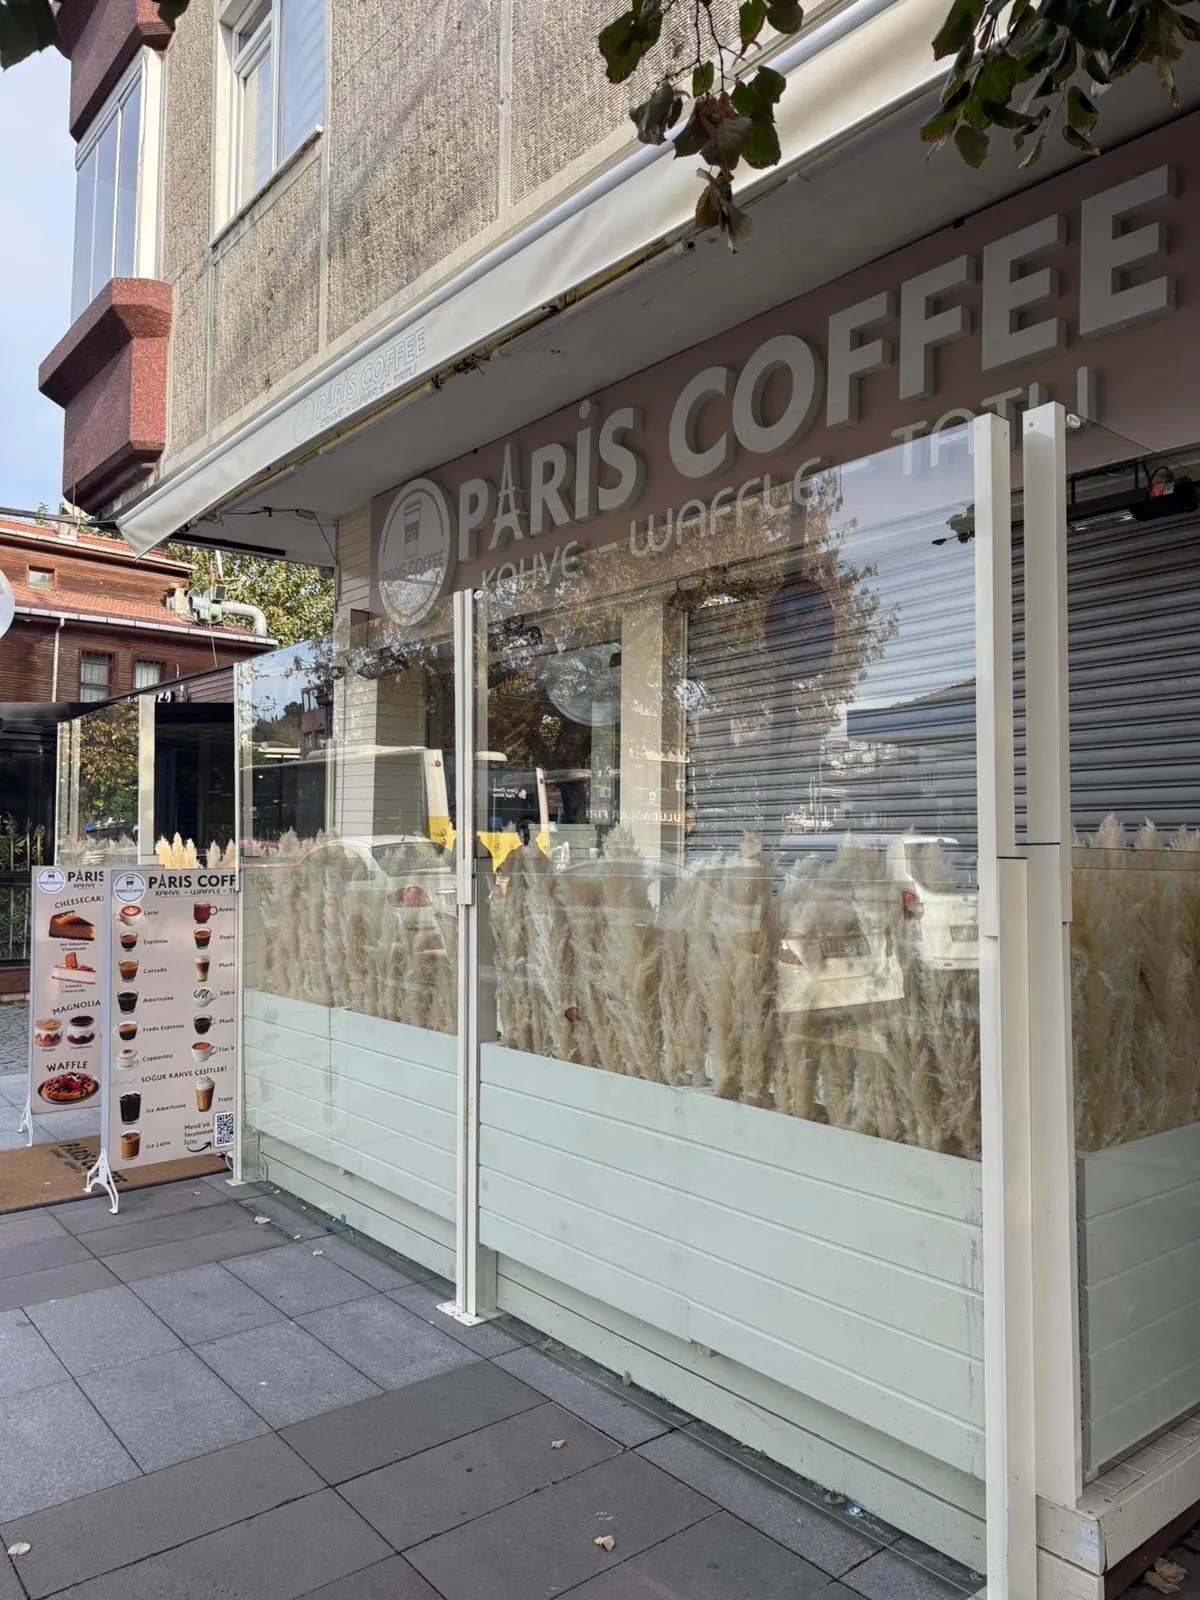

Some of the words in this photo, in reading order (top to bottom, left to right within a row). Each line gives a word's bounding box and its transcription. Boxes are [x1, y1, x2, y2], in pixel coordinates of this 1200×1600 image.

[667, 164, 1170, 478] COFFEE
[361, 327, 425, 389] COFFEE
[481, 540, 581, 593] KAHVE
[629, 456, 823, 558] WAFFLE
[408, 549, 445, 576] COFFEE
[52, 999, 101, 1015] MAGNOLIA
[143, 995, 174, 1004] Americano
[46, 1060, 88, 1072] WAFFLE
[141, 1073, 167, 1083] SOĞUK
[168, 1070, 193, 1079] KAHVE
[156, 1103, 187, 1112] Americano
